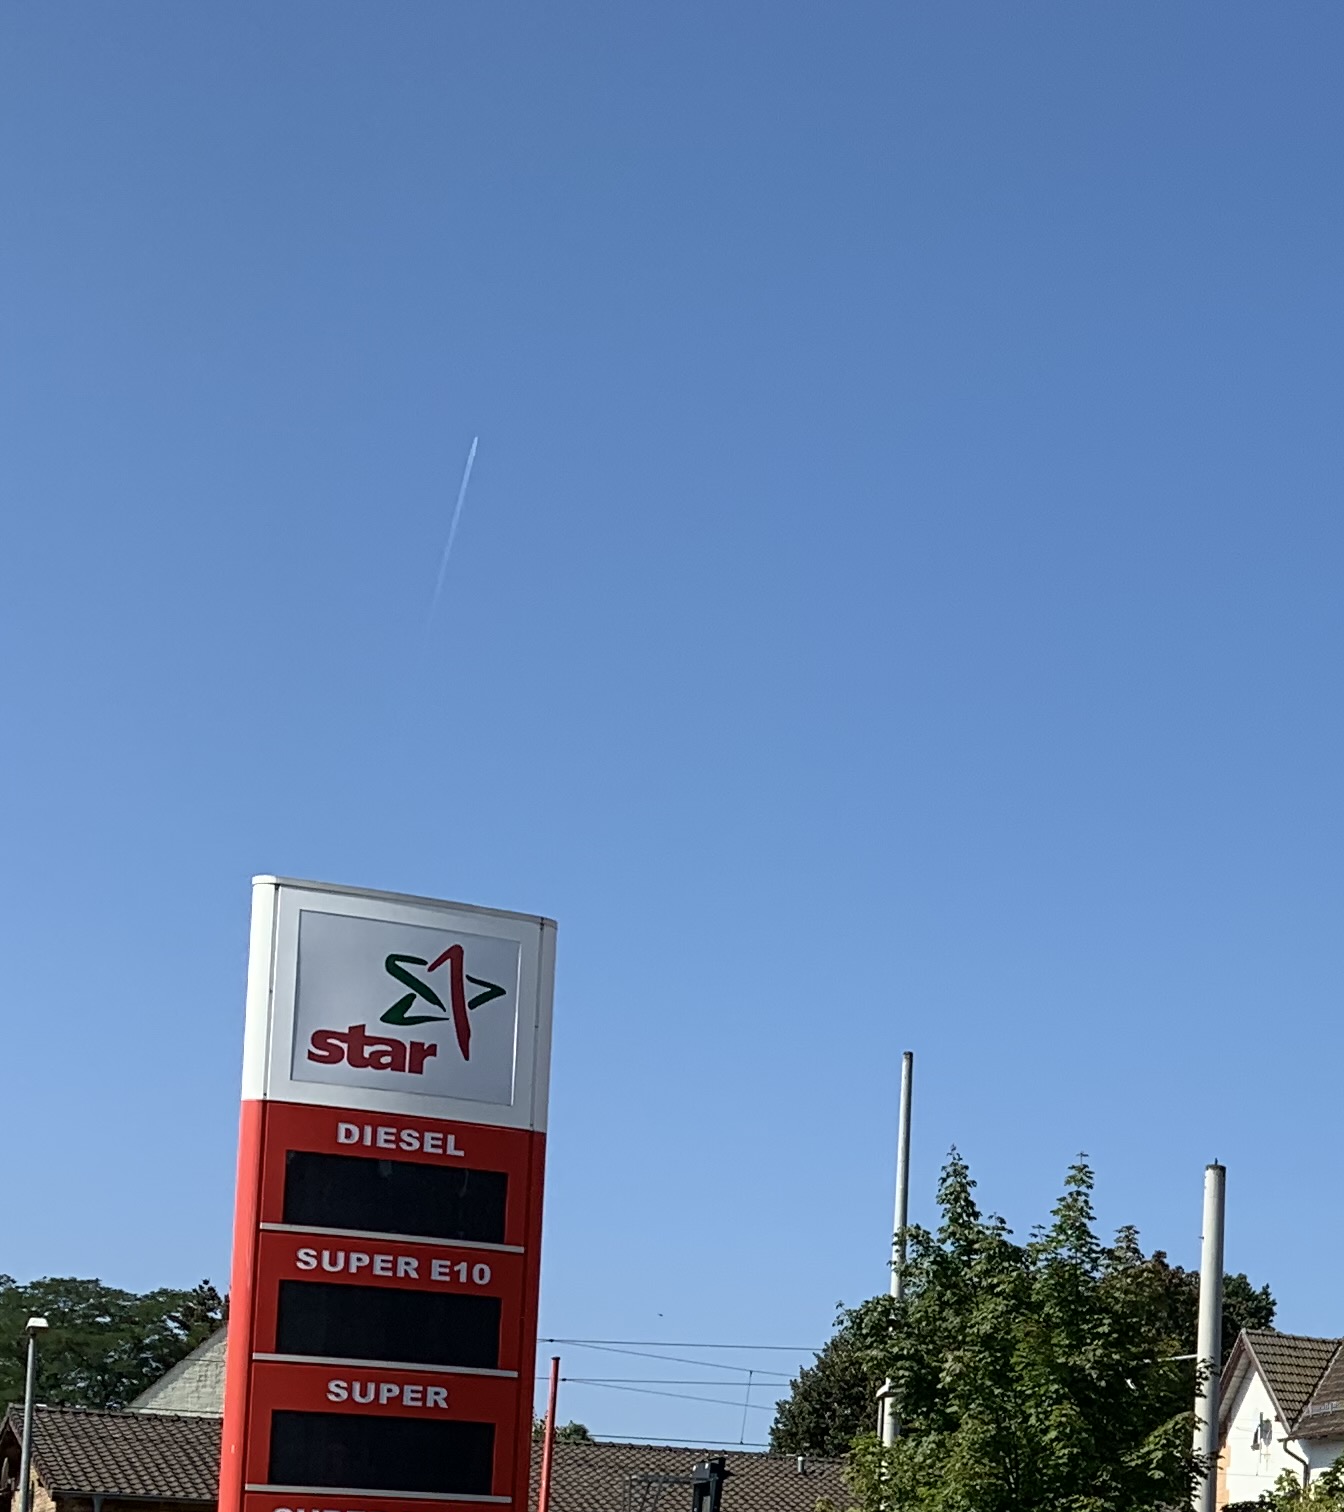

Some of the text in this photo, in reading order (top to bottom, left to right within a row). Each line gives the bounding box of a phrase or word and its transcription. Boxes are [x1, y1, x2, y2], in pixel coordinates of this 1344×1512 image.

[307, 1024, 437, 1074] star
[337, 1122, 465, 1156] DIESEL
[296, 1248, 491, 1285] SUPER E10
[327, 1380, 448, 1408] SUPER
